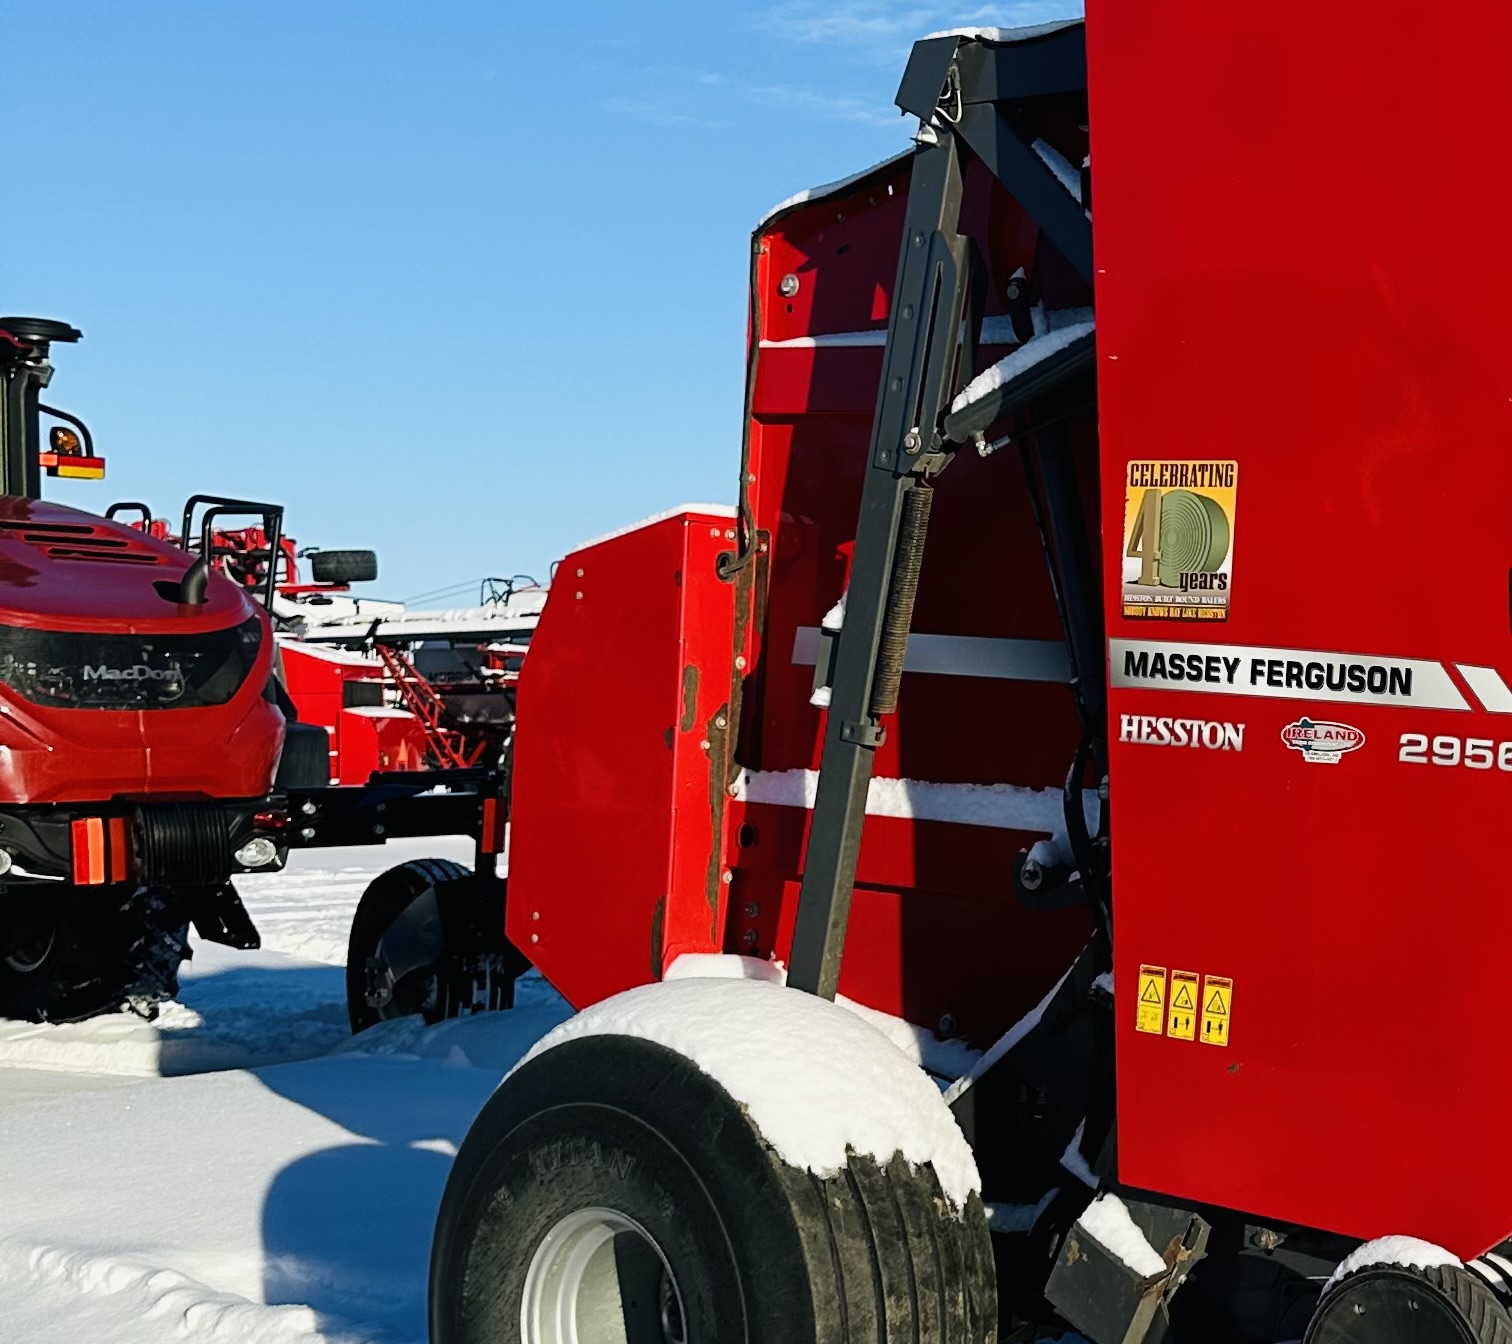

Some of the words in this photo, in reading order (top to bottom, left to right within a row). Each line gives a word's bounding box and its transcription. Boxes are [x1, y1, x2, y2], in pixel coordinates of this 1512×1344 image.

[1129, 463, 1235, 488] CELEBRATING
[1179, 572, 1228, 592] years
[83, 664, 180, 681] MacDon
[1124, 650, 1241, 684] MASSEY
[1250, 657, 1413, 696] FERGUSON
[1119, 714, 1245, 751] HESSTON
[1286, 728, 1359, 741] IRELAND
